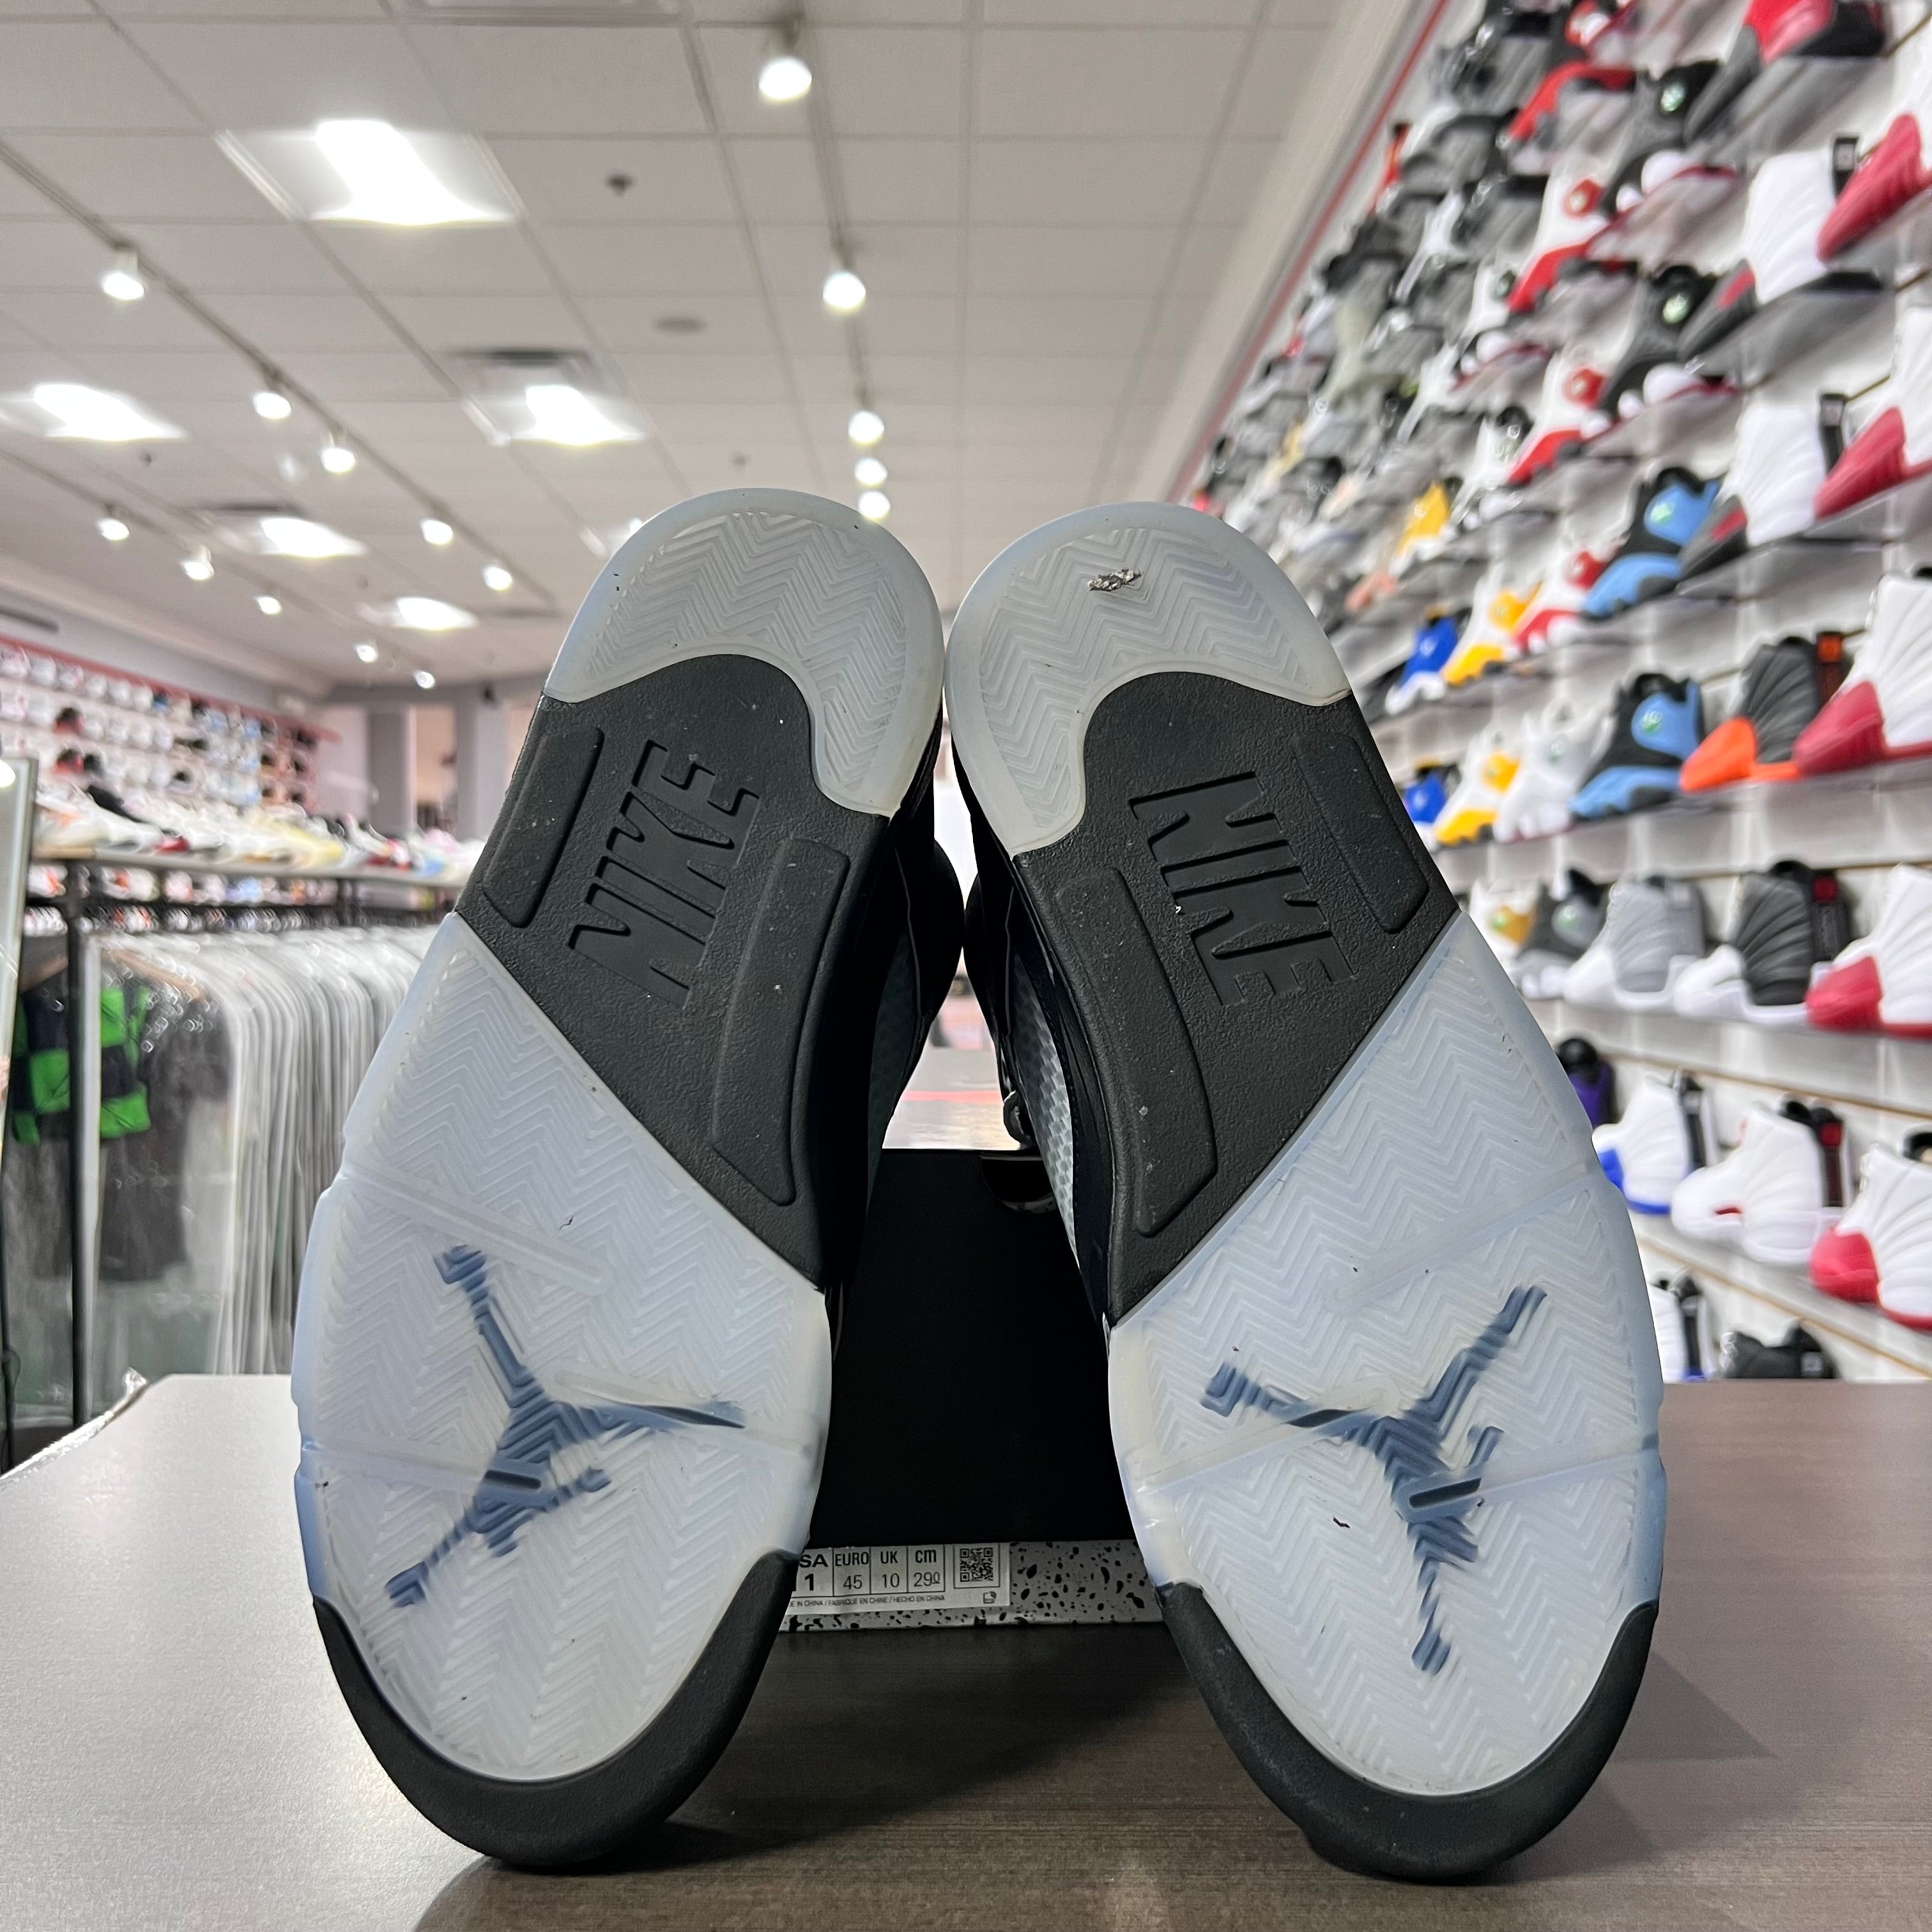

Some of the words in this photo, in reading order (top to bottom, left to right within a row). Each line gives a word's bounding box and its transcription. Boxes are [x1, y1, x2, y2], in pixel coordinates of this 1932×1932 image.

[567, 739, 760, 1009] NIKE
[1128, 770, 1358, 1007] NIKE
[799, 1553, 829, 1568] SA
[835, 1551, 869, 1567] EURO
[880, 1550, 898, 1565] UK
[843, 1574, 862, 1590] 45
[883, 1572, 900, 1588] 10
